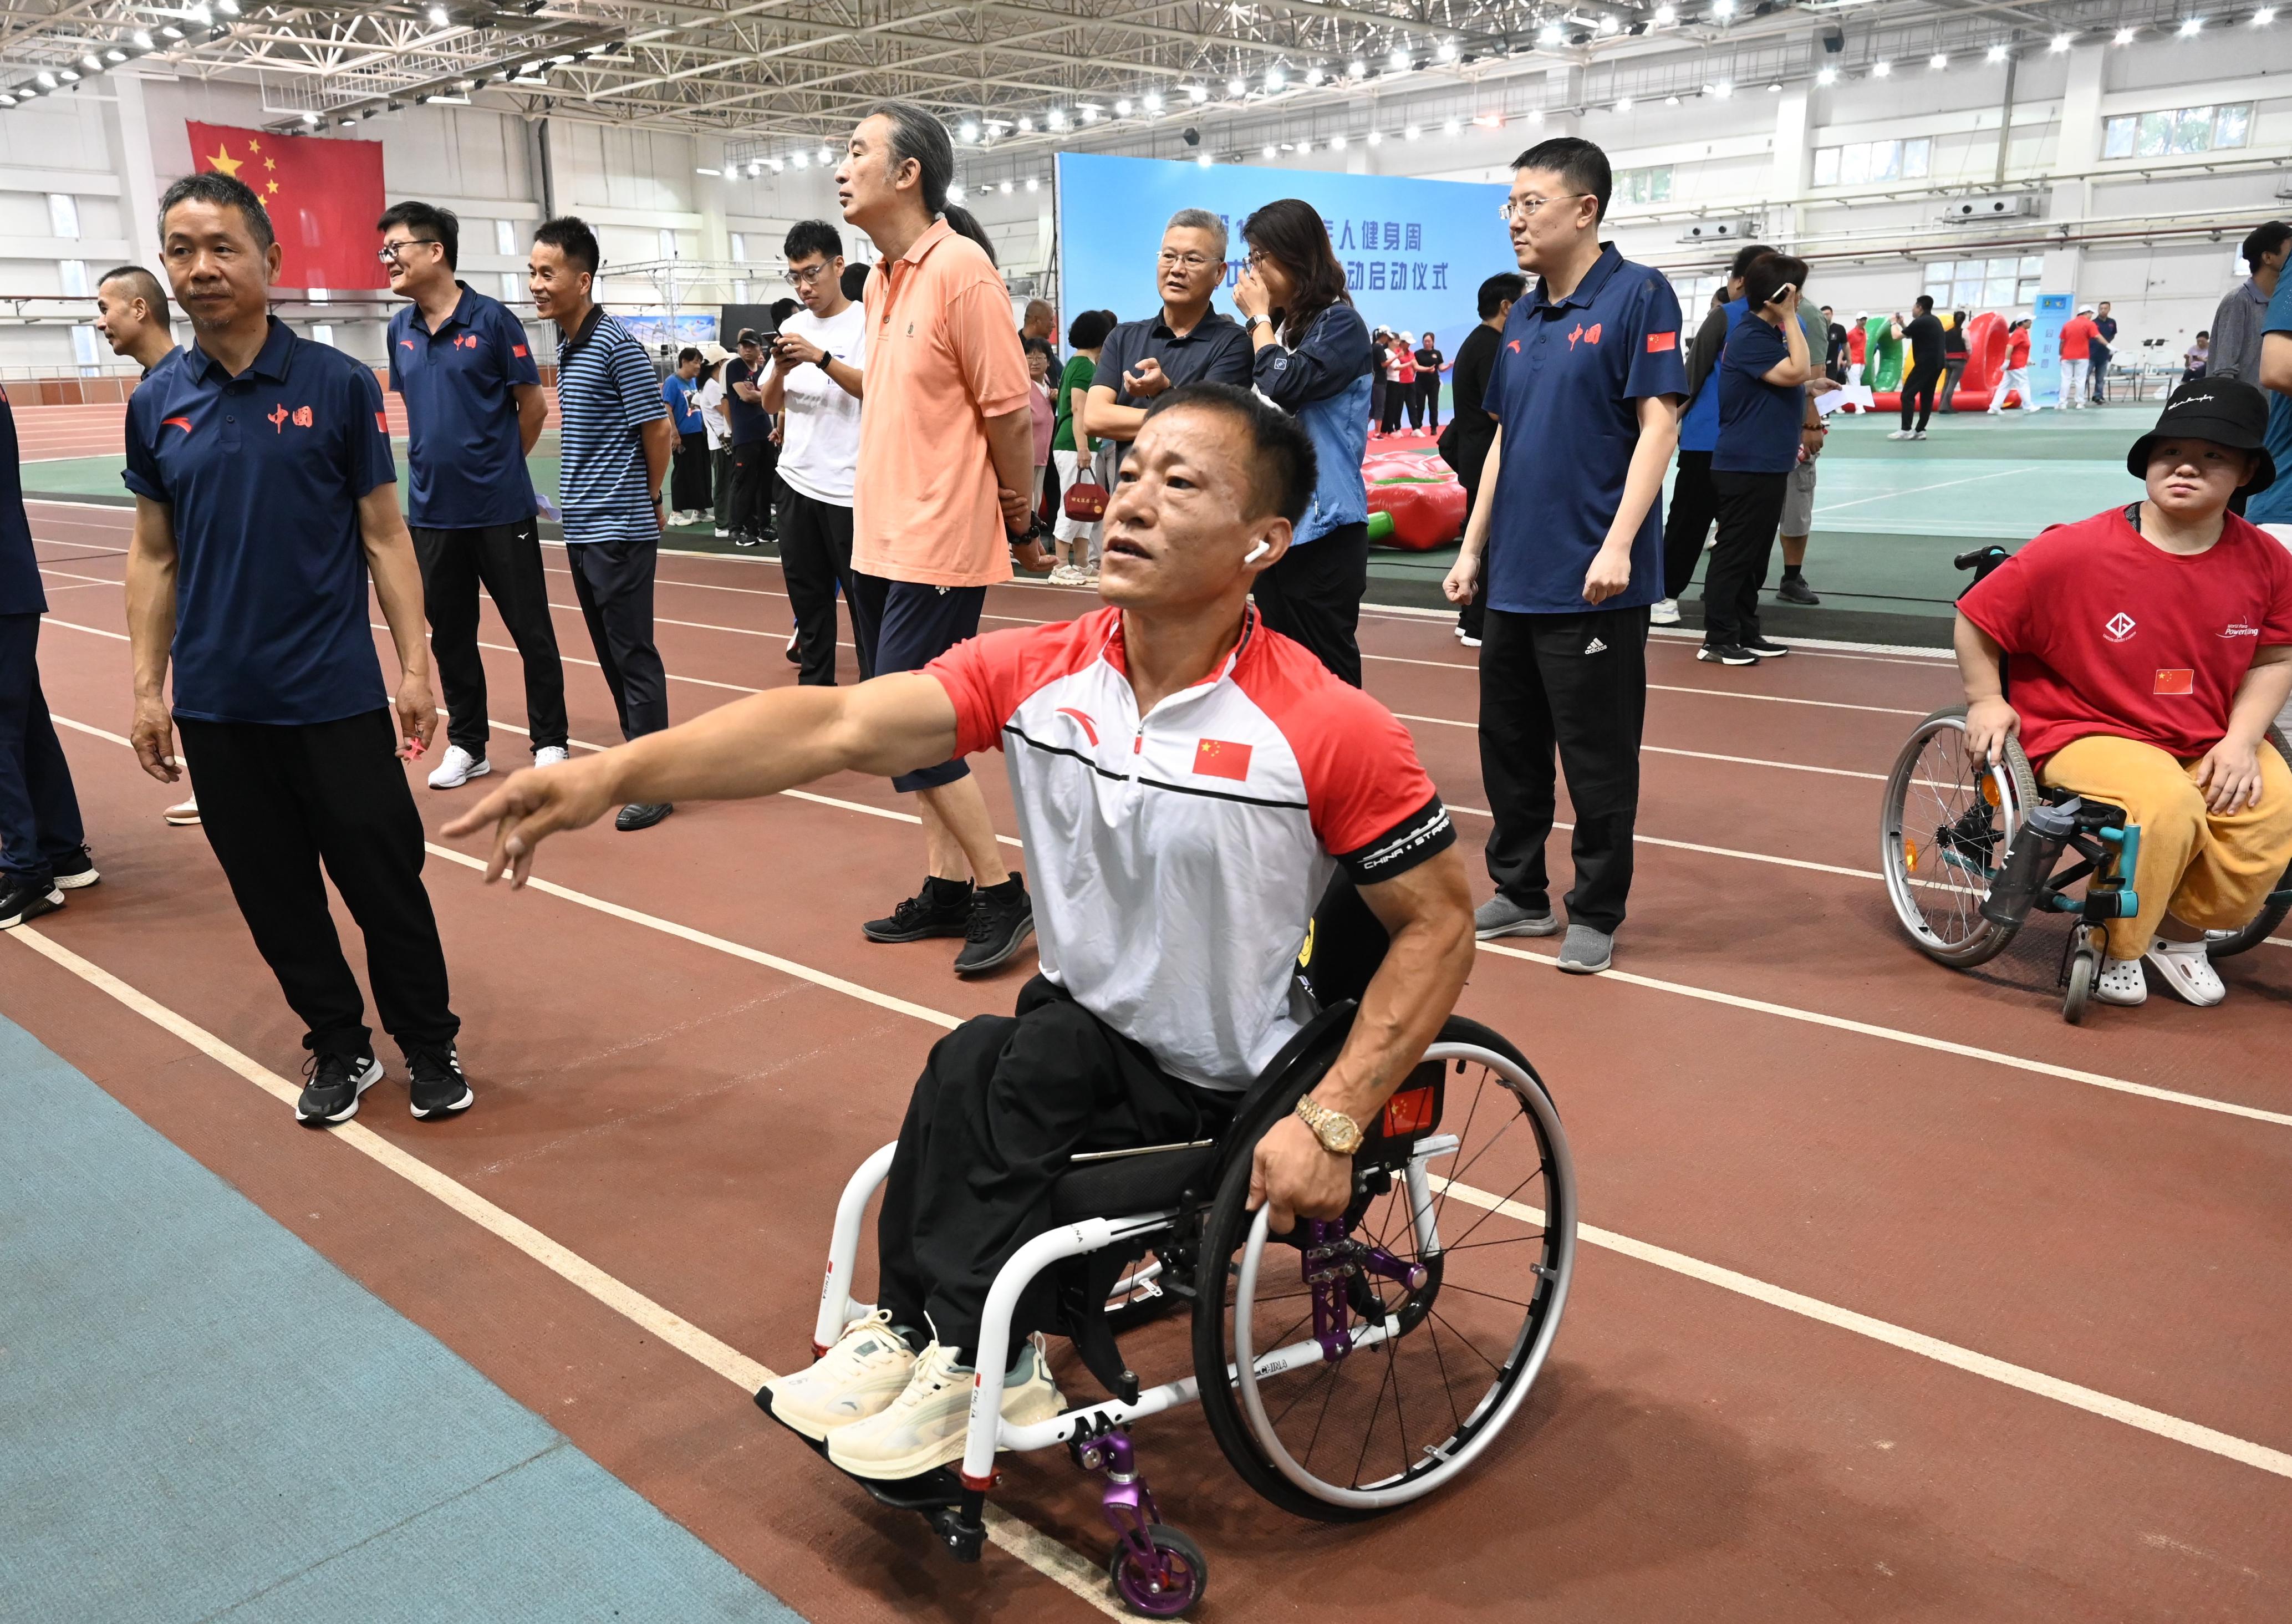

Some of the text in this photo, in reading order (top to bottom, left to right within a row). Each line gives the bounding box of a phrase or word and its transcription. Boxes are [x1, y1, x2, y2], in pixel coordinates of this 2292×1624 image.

[1585, 644, 1607, 654] adidas
[1364, 848, 1403, 869] CHINA
[1260, 1359, 1287, 1375] CHINA
